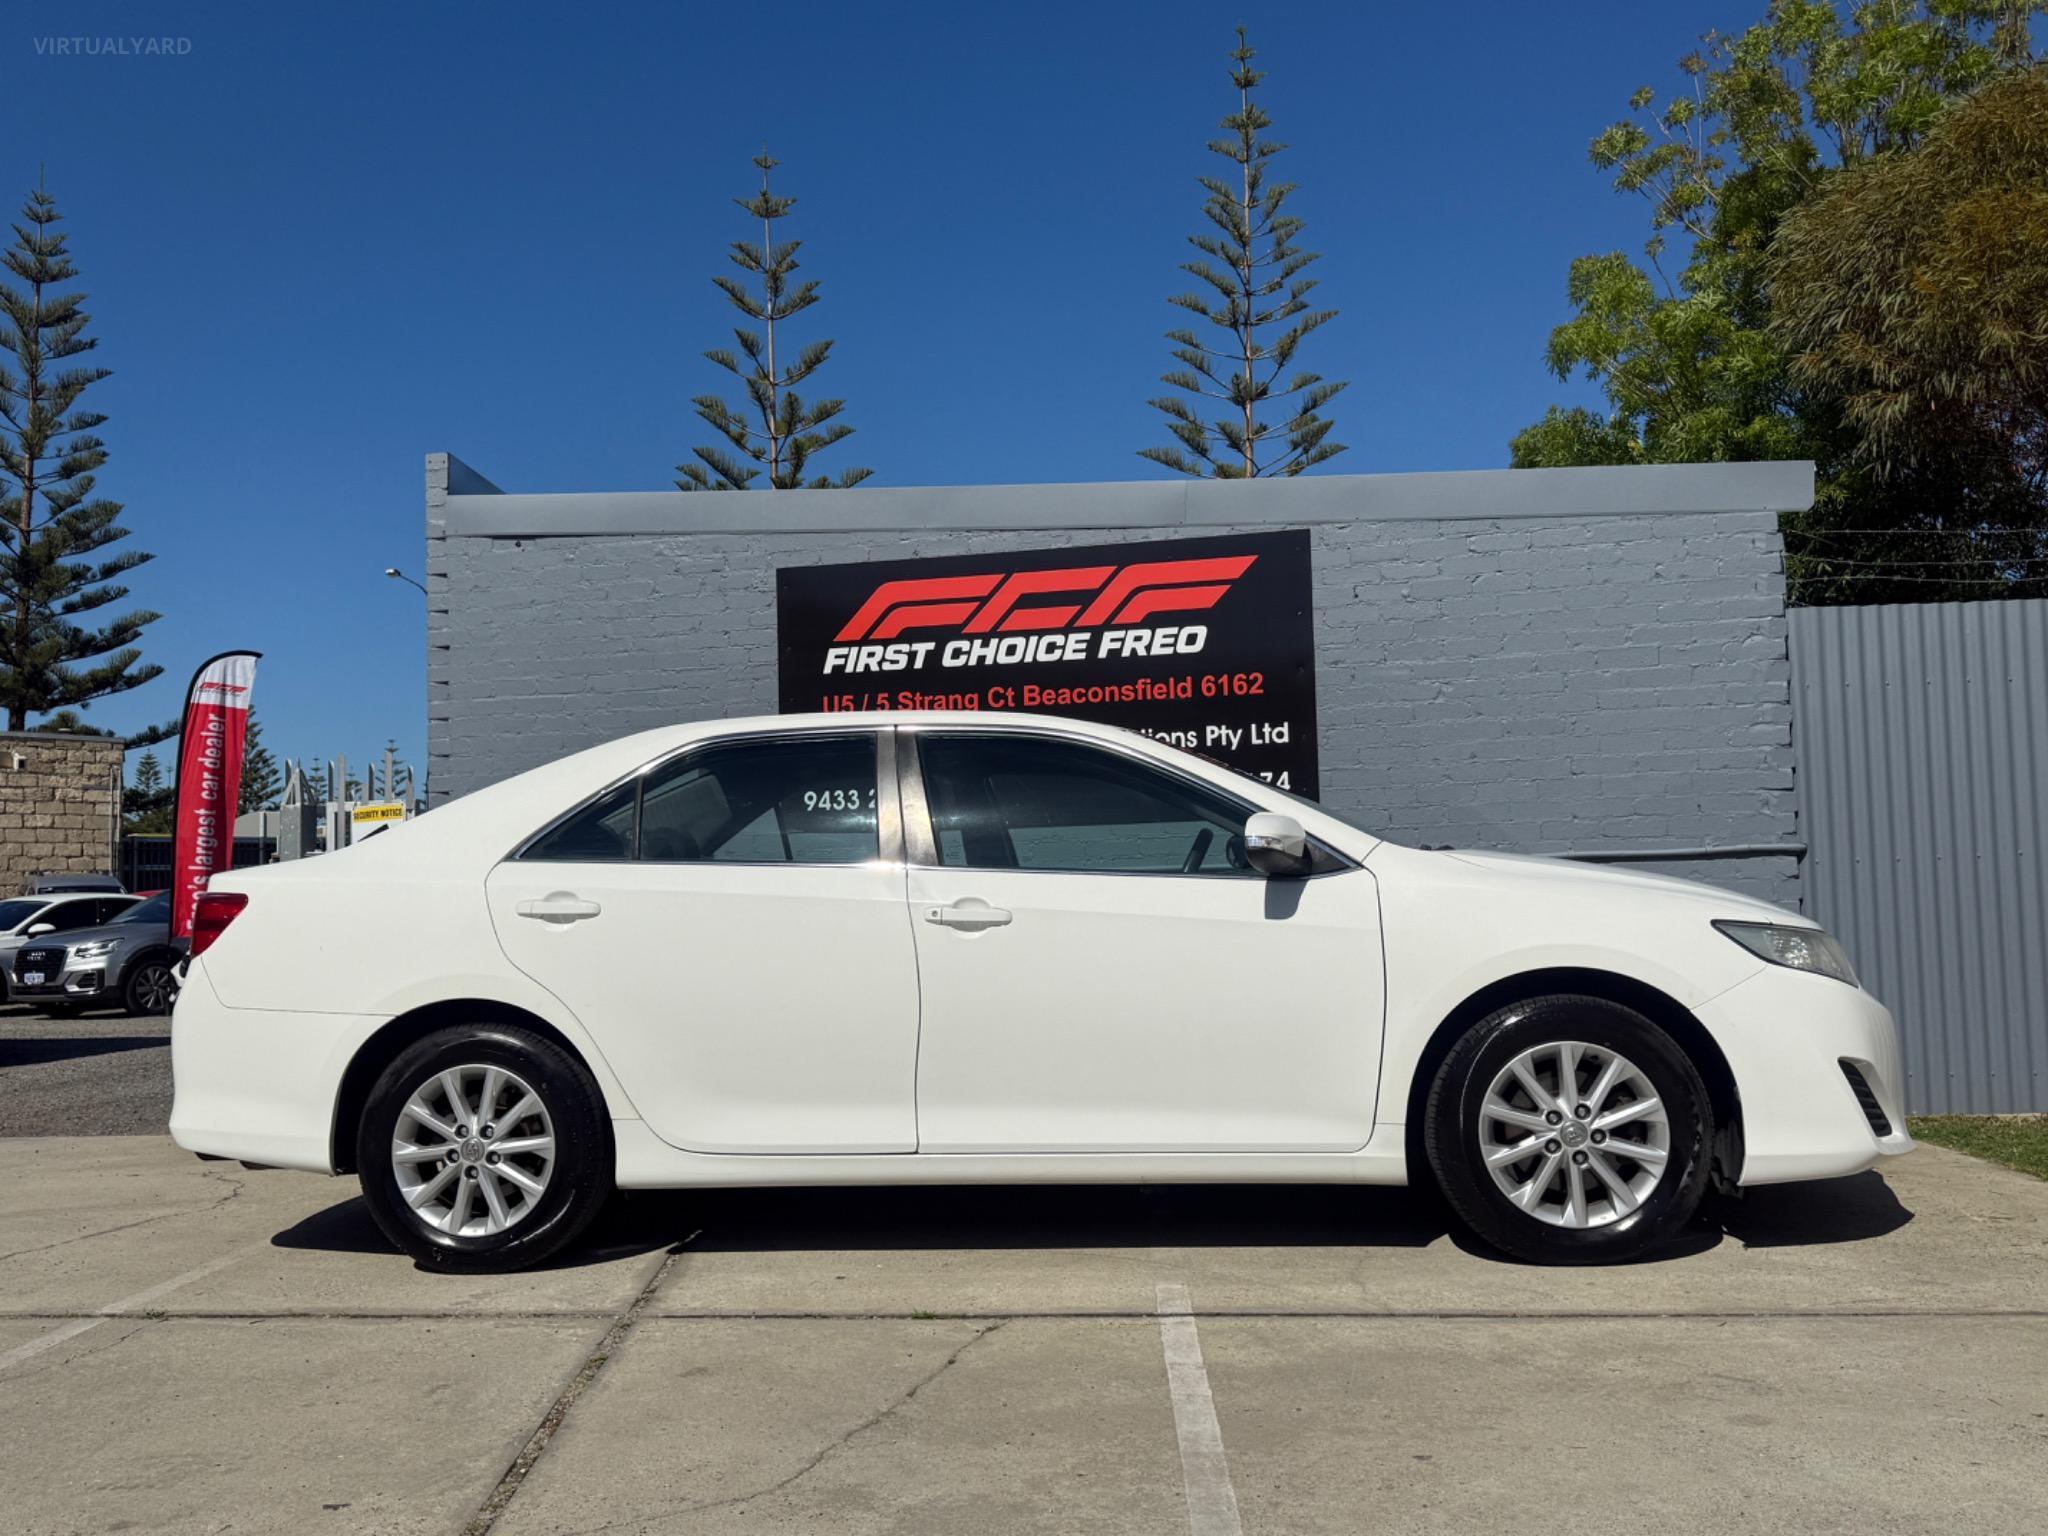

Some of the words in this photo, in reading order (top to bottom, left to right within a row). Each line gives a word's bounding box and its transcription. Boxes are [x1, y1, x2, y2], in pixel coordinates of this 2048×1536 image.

[823, 642, 936, 675] FIRST
[942, 632, 1091, 668] CHOICE
[1097, 625, 1208, 659] FREO
[876, 692, 890, 711] 5
[897, 690, 979, 711] Strang
[987, 685, 1015, 708] Ct
[1023, 676, 1193, 707] Beaconsfield
[1201, 672, 1265, 697] 6162
[198, 713, 225, 769] dealer
[1205, 724, 1243, 750] Pty
[1251, 721, 1290, 745] Ltd
[201, 771, 220, 800] car
[804, 789, 860, 811] 9433
[188, 808, 218, 870] largest
